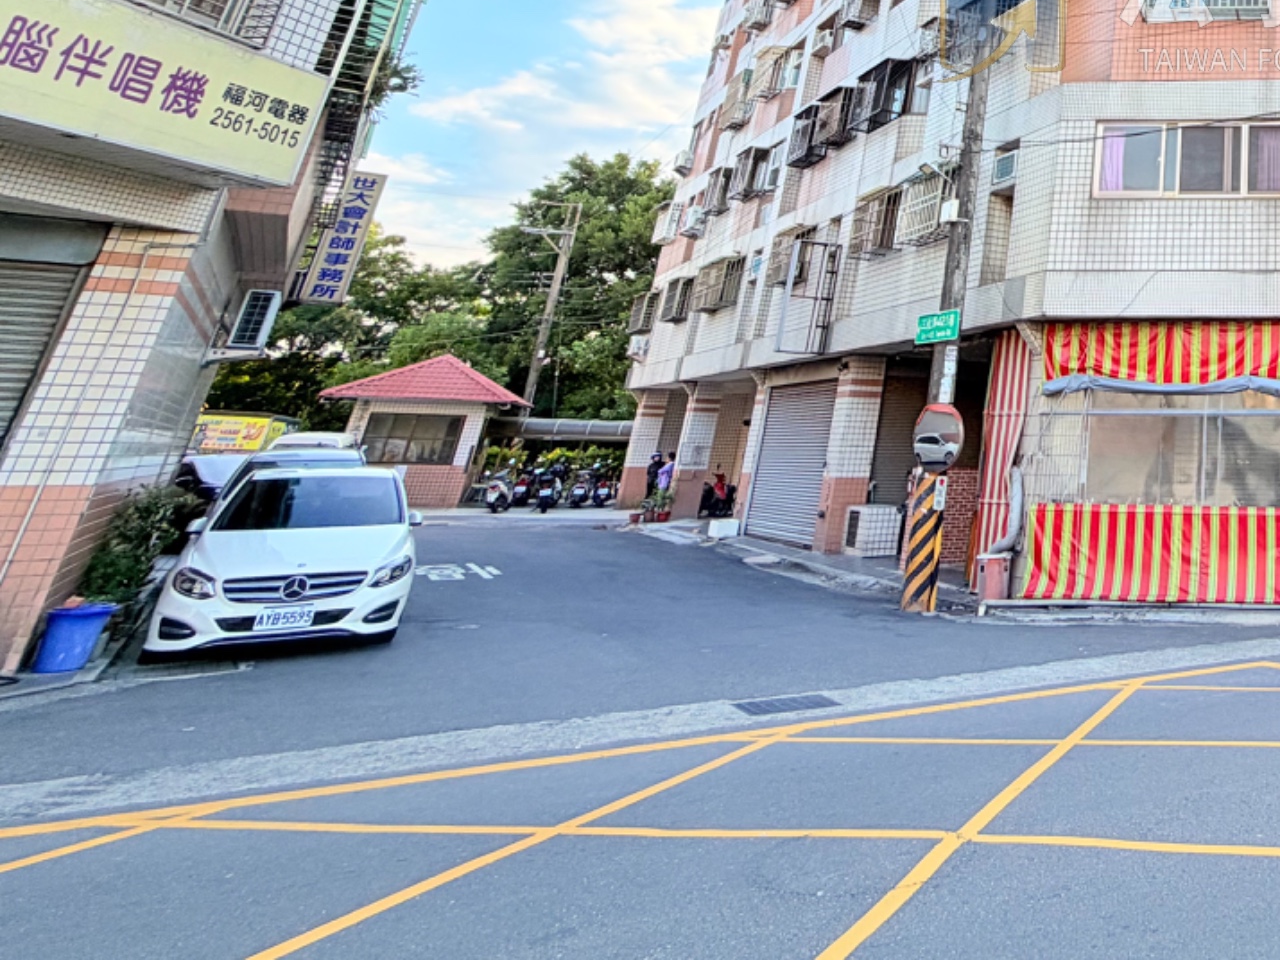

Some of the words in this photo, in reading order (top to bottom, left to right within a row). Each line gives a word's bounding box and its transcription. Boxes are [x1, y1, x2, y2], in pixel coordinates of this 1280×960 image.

[0, 15, 209, 120] 腦伴唱機
[222, 81, 310, 126] 福河電器
[210, 106, 301, 149] 2561-5015
[309, 176, 379, 300] 世大會計師事務所
